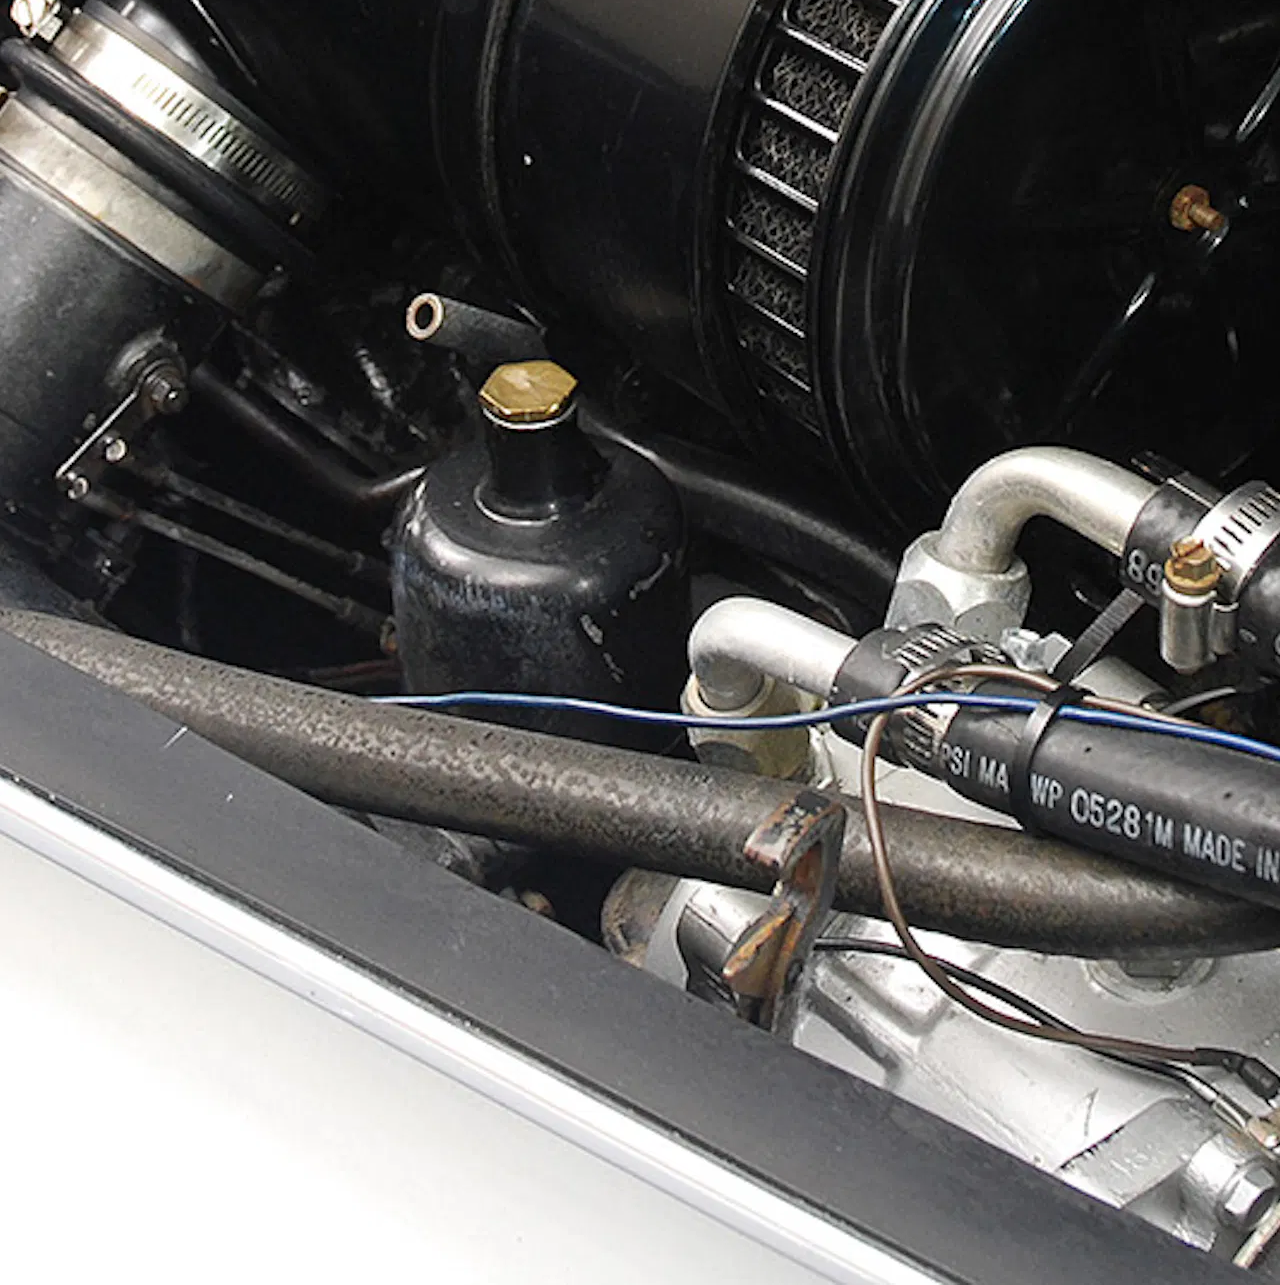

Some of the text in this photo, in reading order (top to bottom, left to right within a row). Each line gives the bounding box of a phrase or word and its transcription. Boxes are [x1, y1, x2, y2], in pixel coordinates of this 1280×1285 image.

[1029, 773, 1064, 809] WP
[1182, 822, 1247, 874] MADE
[1255, 846, 1280, 884] IN
